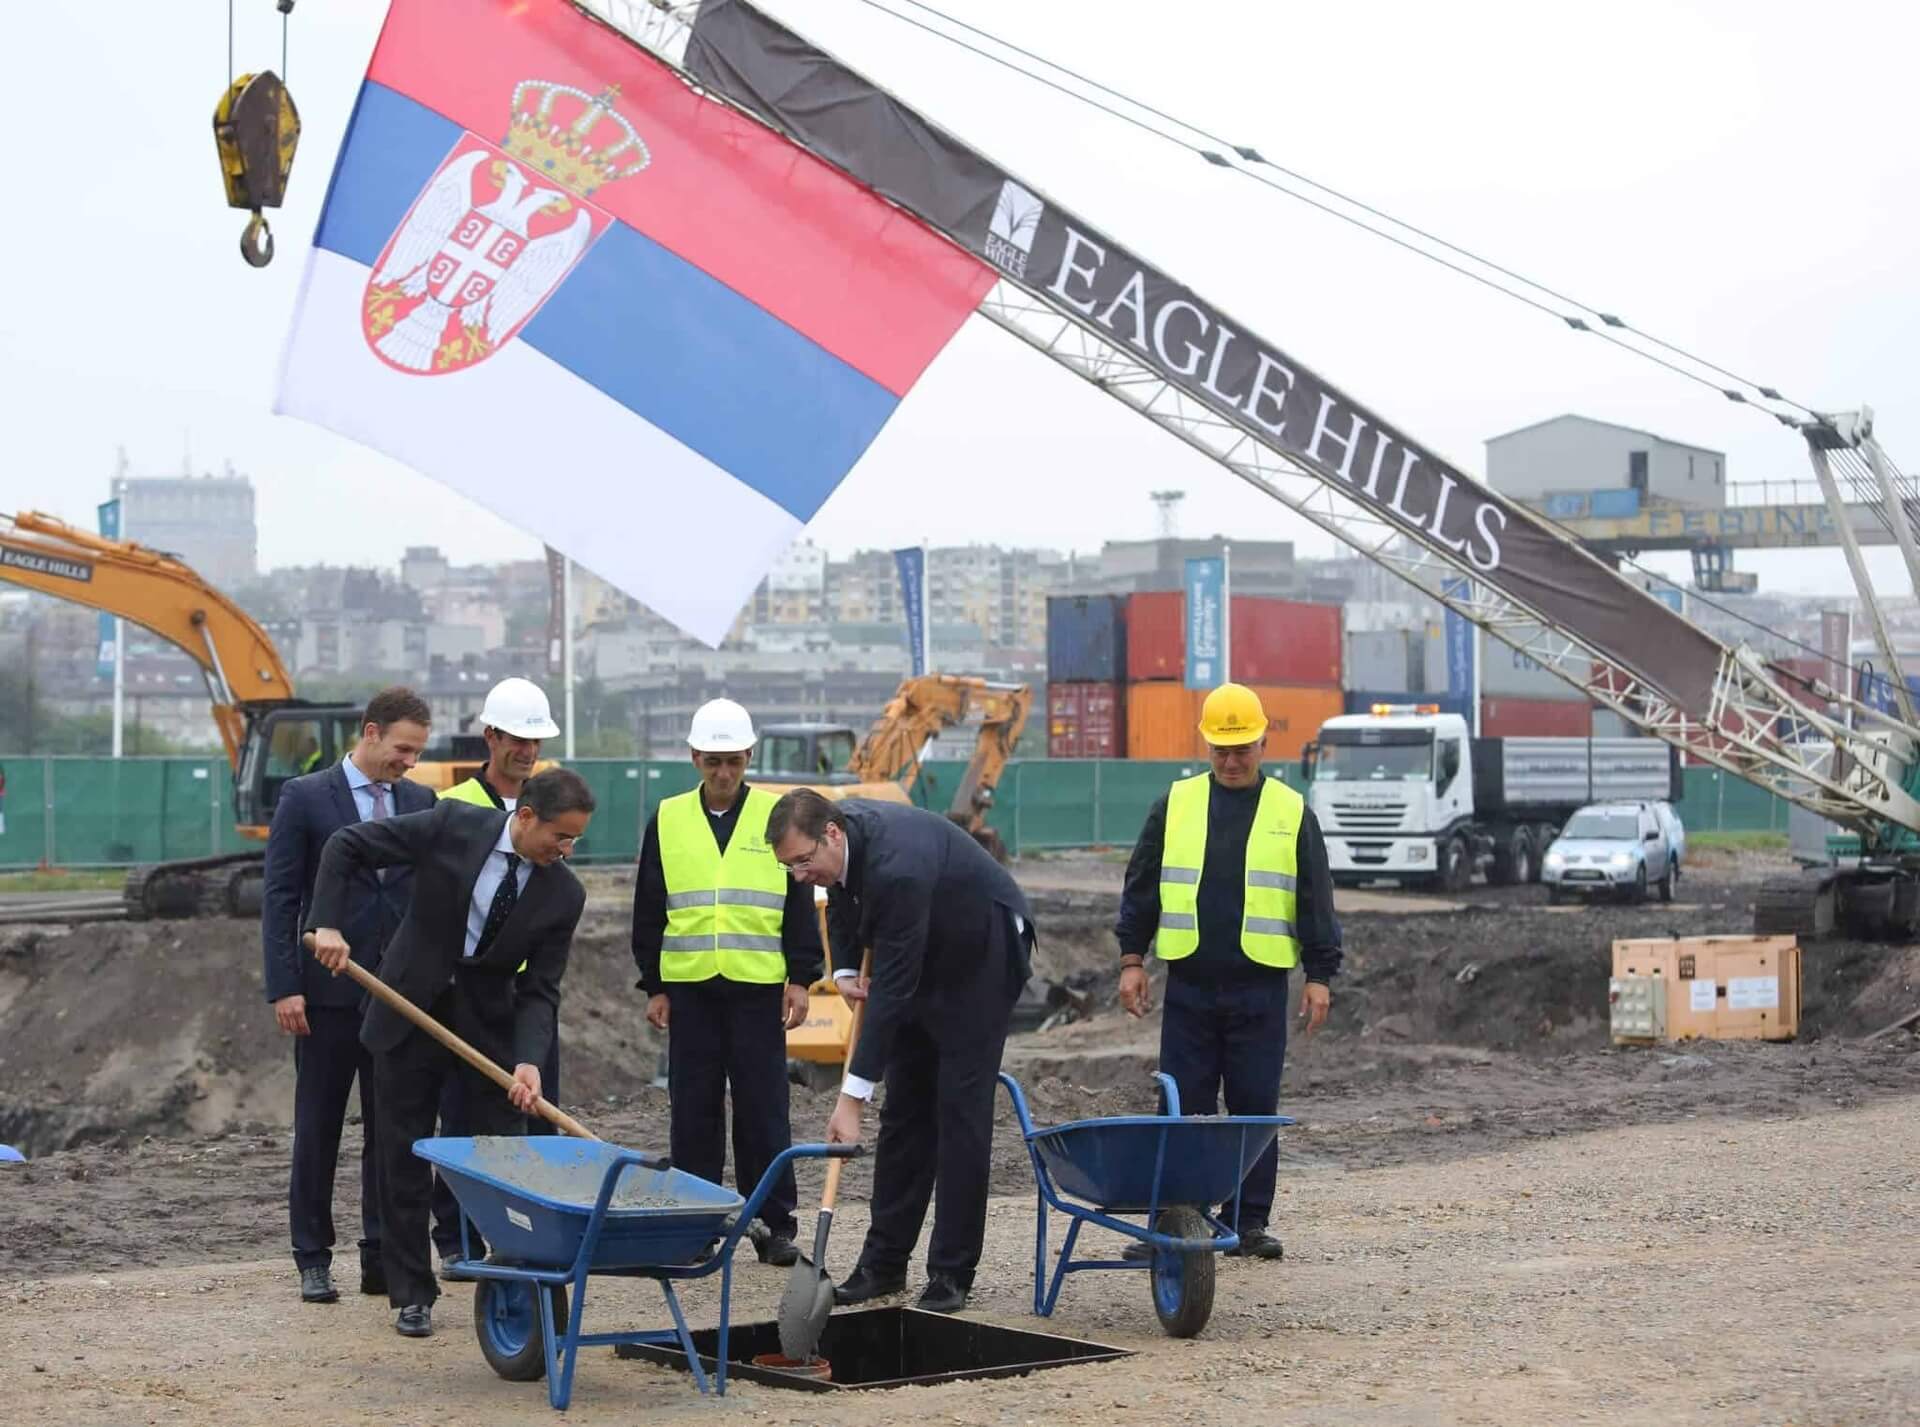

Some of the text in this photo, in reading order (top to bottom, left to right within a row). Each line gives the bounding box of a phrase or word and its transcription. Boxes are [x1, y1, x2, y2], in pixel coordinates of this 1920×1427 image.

[984, 245, 1026, 281] HILLS
[985, 231, 1028, 266] EAGLE
[1046, 226, 1507, 571] EAGLE HILLS
[3, 551, 90, 580] EAGLE HILLS
